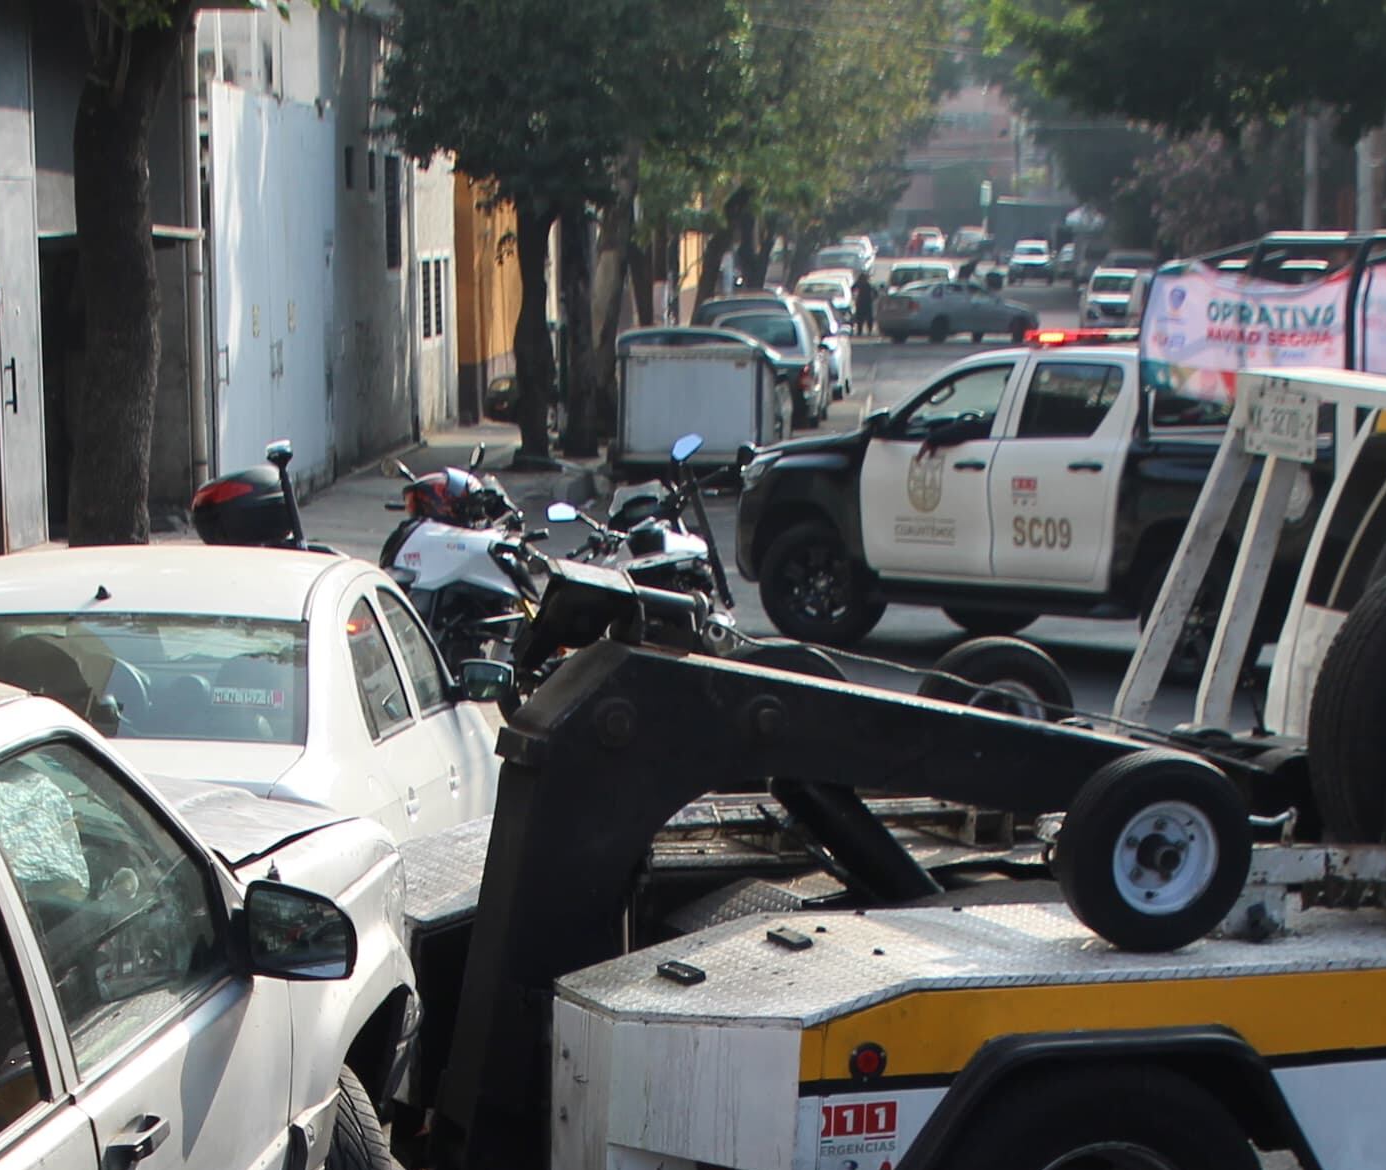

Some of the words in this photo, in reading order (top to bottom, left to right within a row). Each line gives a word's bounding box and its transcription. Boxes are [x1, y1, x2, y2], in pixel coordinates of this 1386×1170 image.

[1013, 515, 1072, 549] SC09
[821, 1103, 893, 1135] 11
[820, 1140, 896, 1157] ERGENCIAS
